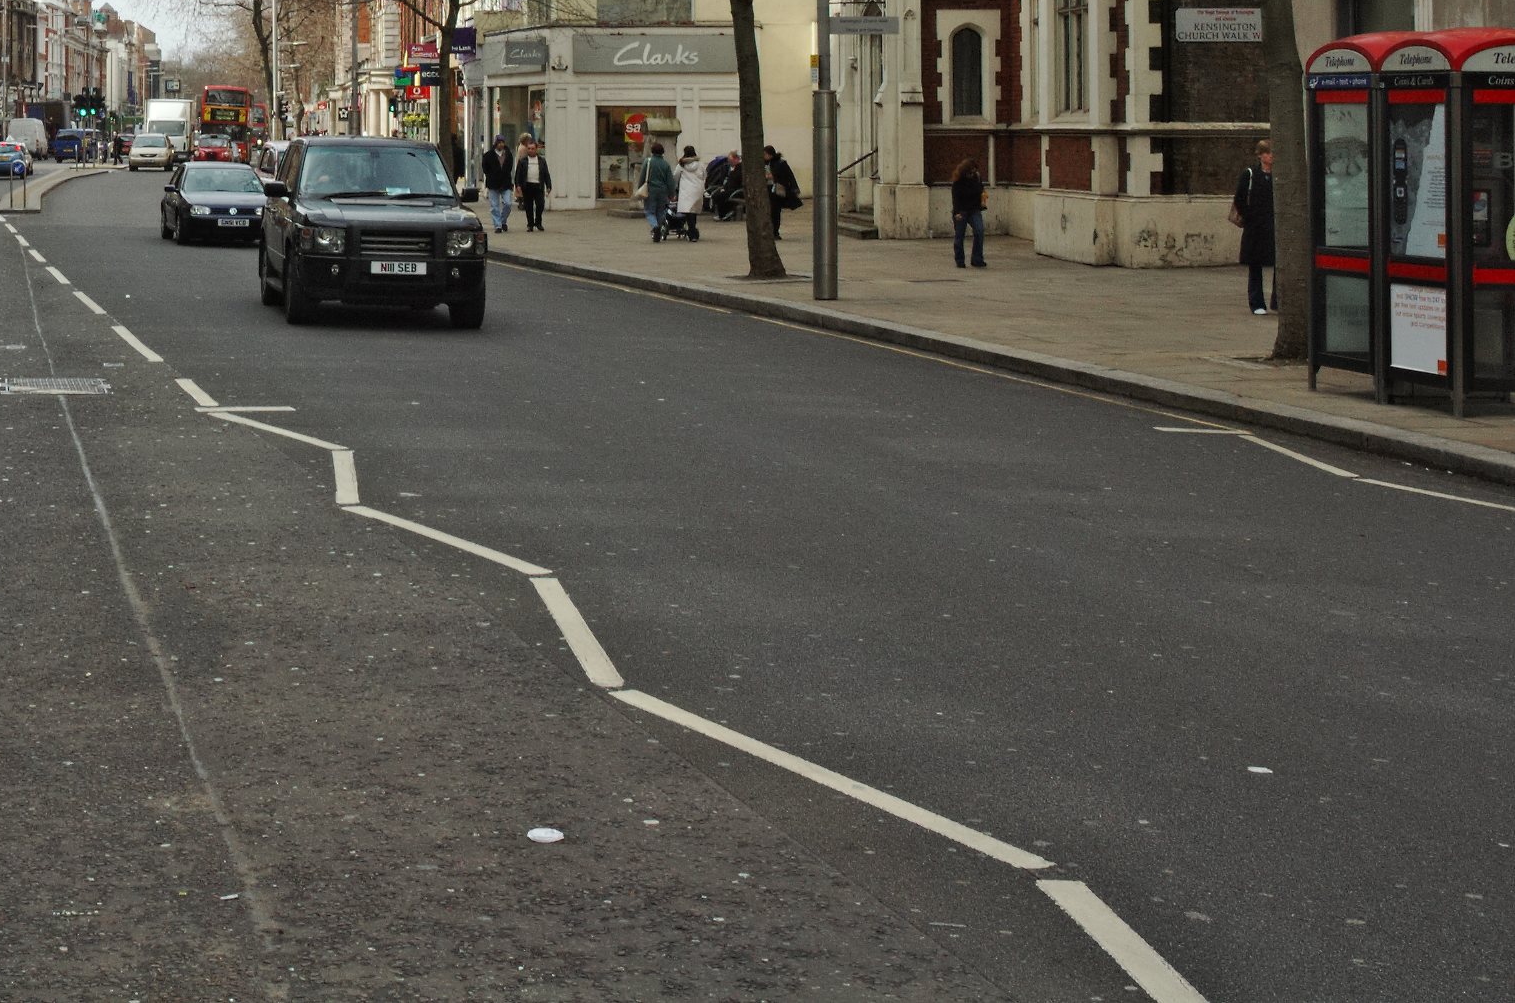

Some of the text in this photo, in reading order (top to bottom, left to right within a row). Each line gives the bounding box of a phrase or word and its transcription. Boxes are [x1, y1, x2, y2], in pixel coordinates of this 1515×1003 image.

[1194, 23, 1256, 31] KENSINGTON
[1177, 32, 1219, 40] CHURCH
[1222, 32, 1250, 40] WALK
[509, 47, 542, 59] Clarks
[613, 41, 700, 66] Clarks
[1325, 56, 1355, 68] Telephone
[1400, 52, 1433, 67] Telephone
[1488, 76, 1515, 85] Coins
[397, 262, 417, 273] SEB
